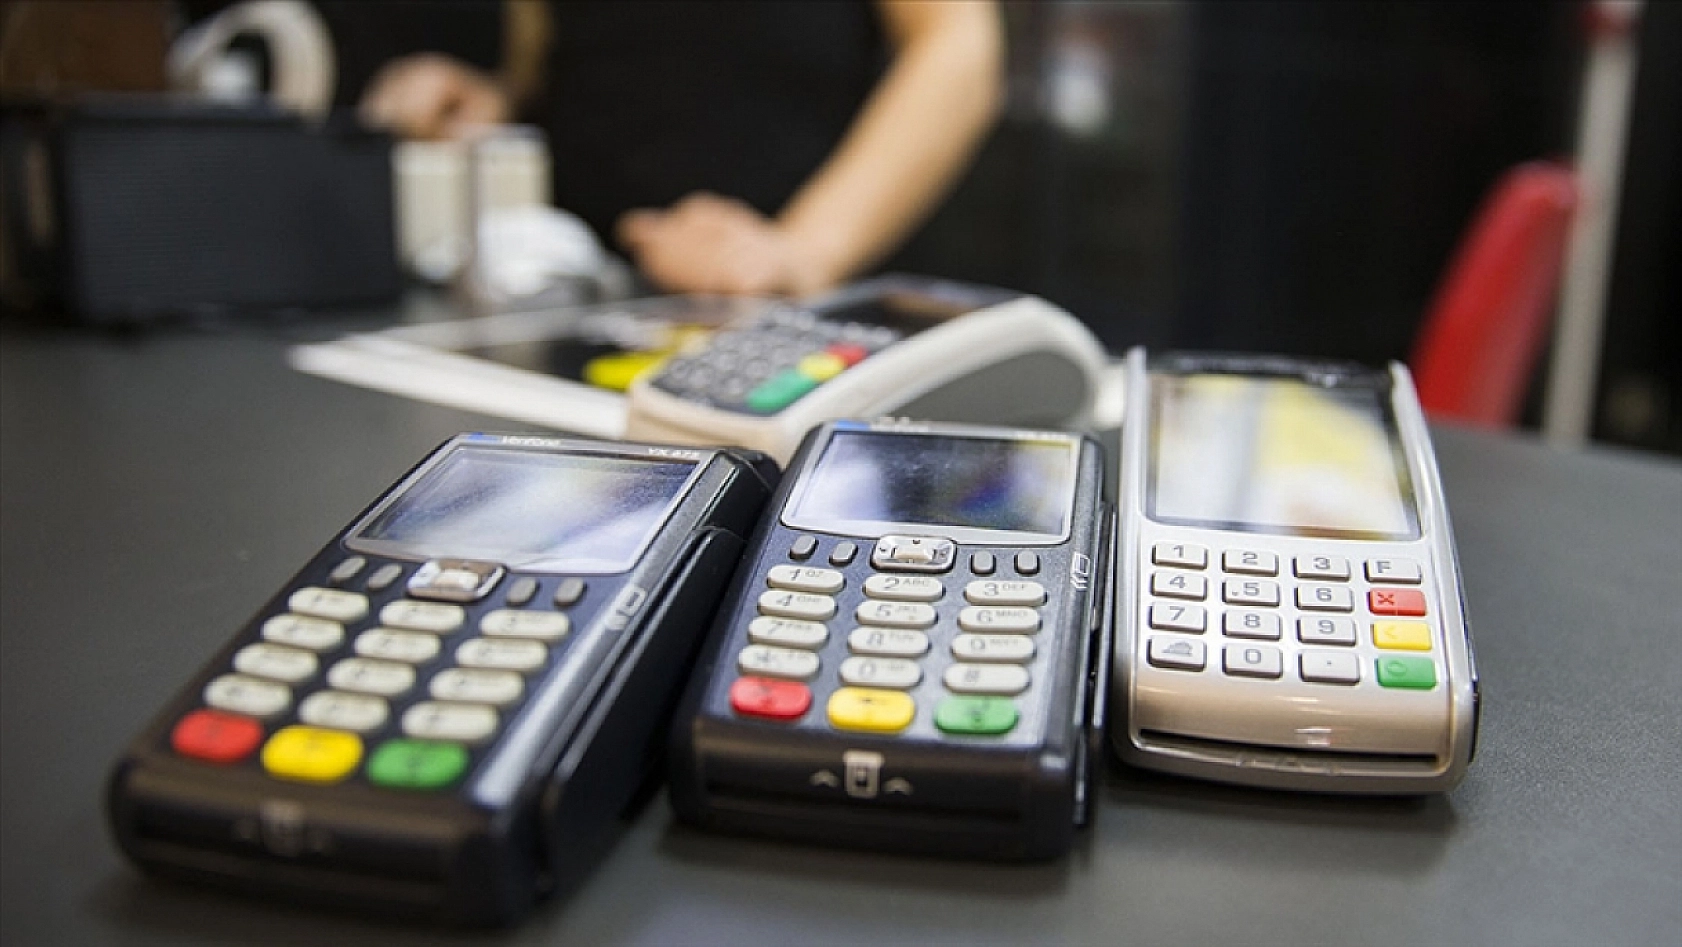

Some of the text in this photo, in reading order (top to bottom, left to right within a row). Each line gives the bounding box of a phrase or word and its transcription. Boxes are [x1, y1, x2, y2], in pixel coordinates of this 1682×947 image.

[1173, 545, 1185, 558] 1
[1242, 551, 1258, 565] 2
[1313, 557, 1331, 570] 3
[1376, 561, 1392, 574] F
[789, 568, 801, 581] 1
[884, 577, 900, 589] 2
[1169, 576, 1186, 589] 4
[1243, 582, 1260, 596] 5
[983, 583, 999, 596] 3
[1316, 588, 1332, 602] 6
[776, 594, 793, 606] 4
[876, 605, 892, 617] 5
[976, 610, 993, 623] 6
[1169, 605, 1186, 621] 7
[1244, 613, 1261, 628] 8
[1318, 619, 1335, 635] 9
[1245, 648, 1262, 664] 0
